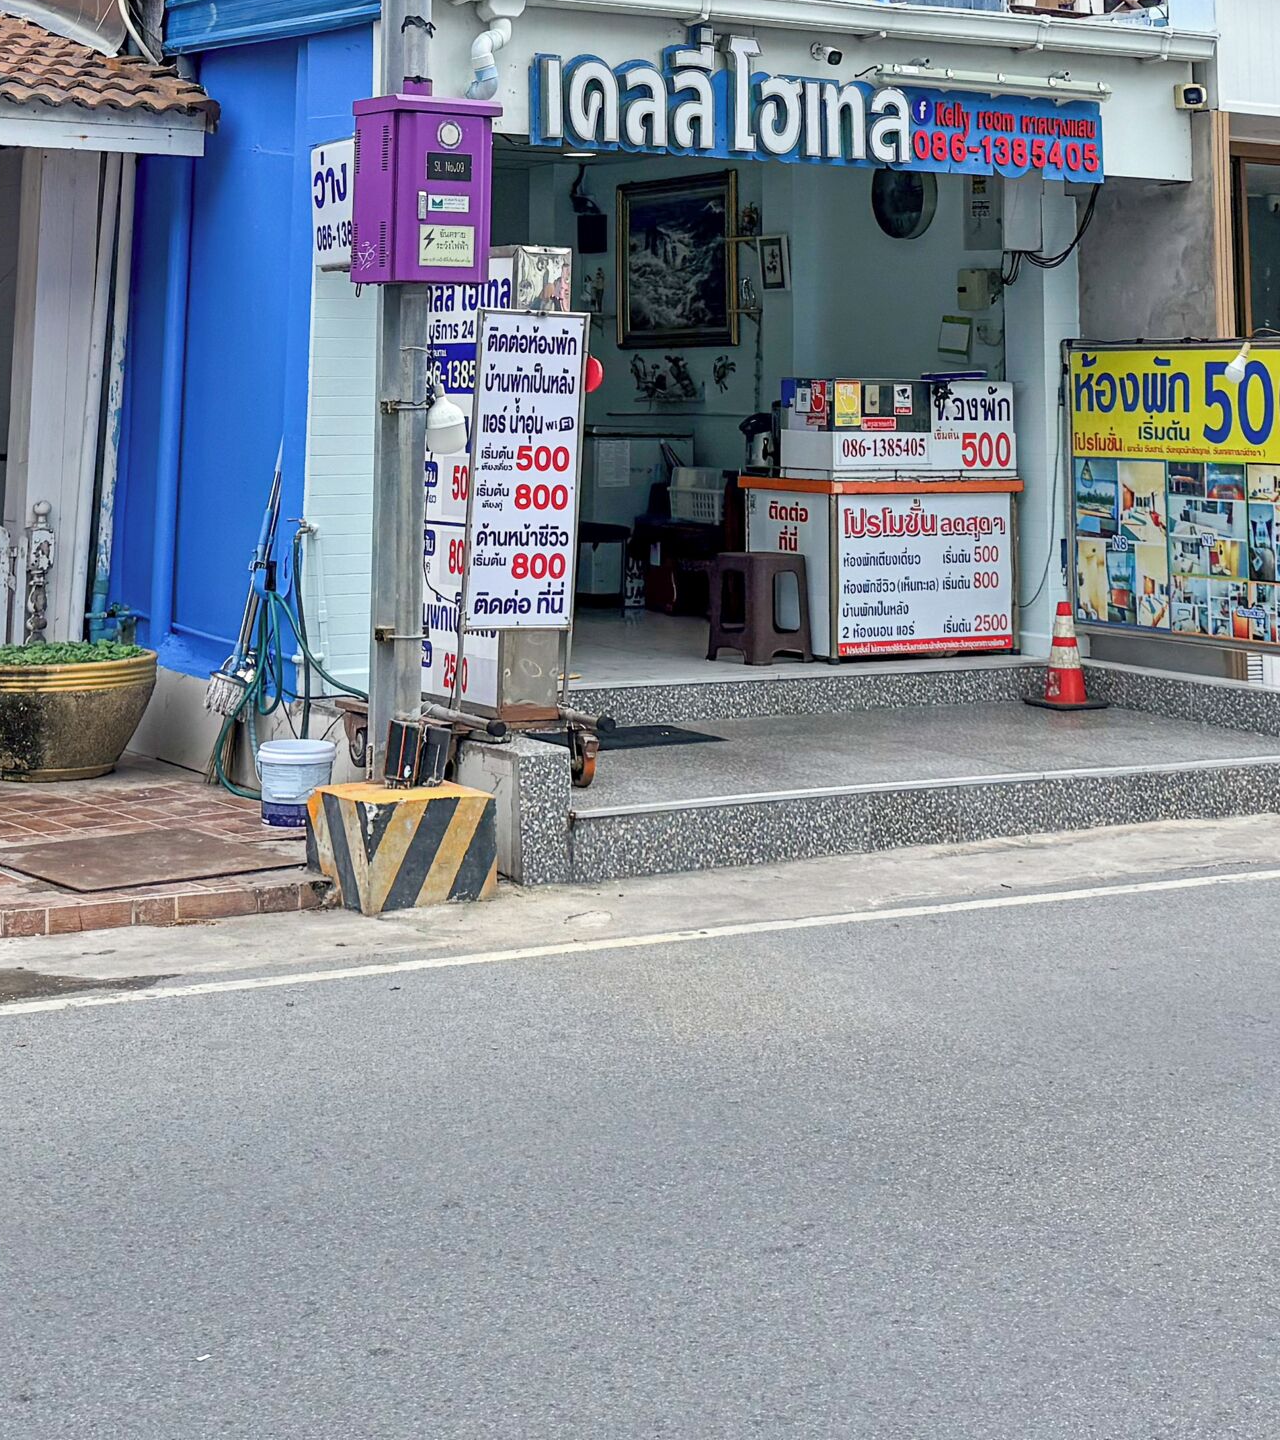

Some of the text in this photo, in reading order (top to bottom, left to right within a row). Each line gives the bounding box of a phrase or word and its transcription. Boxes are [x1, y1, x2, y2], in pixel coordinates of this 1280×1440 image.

[935, 101, 971, 139] Kelly
[977, 111, 1015, 133] room
[1021, 115, 1096, 139] หาดบางแสน
[913, 130, 1100, 172] 086-1385405
[314, 152, 347, 209] ว่าง
[462, 320, 474, 339] 24
[487, 325, 577, 356] ติดต่อห้องพัก
[485, 363, 575, 395] บ้านพักเป็นหลัง
[1074, 353, 1191, 413] ห้องพัก
[482, 405, 506, 433] แอร์
[510, 398, 544, 444] น้ำอุ่น
[1138, 415, 1190, 441] เริ่มต้น
[842, 437, 926, 458] 086-1385405
[962, 432, 1011, 467] 500
[1074, 427, 1123, 452] โปรโมชั่น
[480, 442, 570, 472] เริ่มต้น 500
[476, 480, 569, 510] เริ่มต้น 800
[769, 501, 808, 523] ติดต่อ
[843, 499, 938, 538] โปรโมชั่น
[476, 523, 569, 547] ด้านหน้าซีวิว
[778, 525, 798, 552] ที่นี่
[473, 550, 566, 579] เริ่มต้น 800
[843, 545, 999, 568] ห้องพักเตียงเดี่ยว เริ่มต้น 500
[942, 572, 971, 590] เริ่มต้น
[973, 571, 999, 589] 800
[474, 589, 531, 615] ติดต่อ
[536, 582, 565, 614] ที่นี่
[842, 600, 909, 618] บ้านพักเป็นหลัง
[842, 614, 1008, 639] 2 ห้องนอน แอร์ เริ่มต้น 2500
